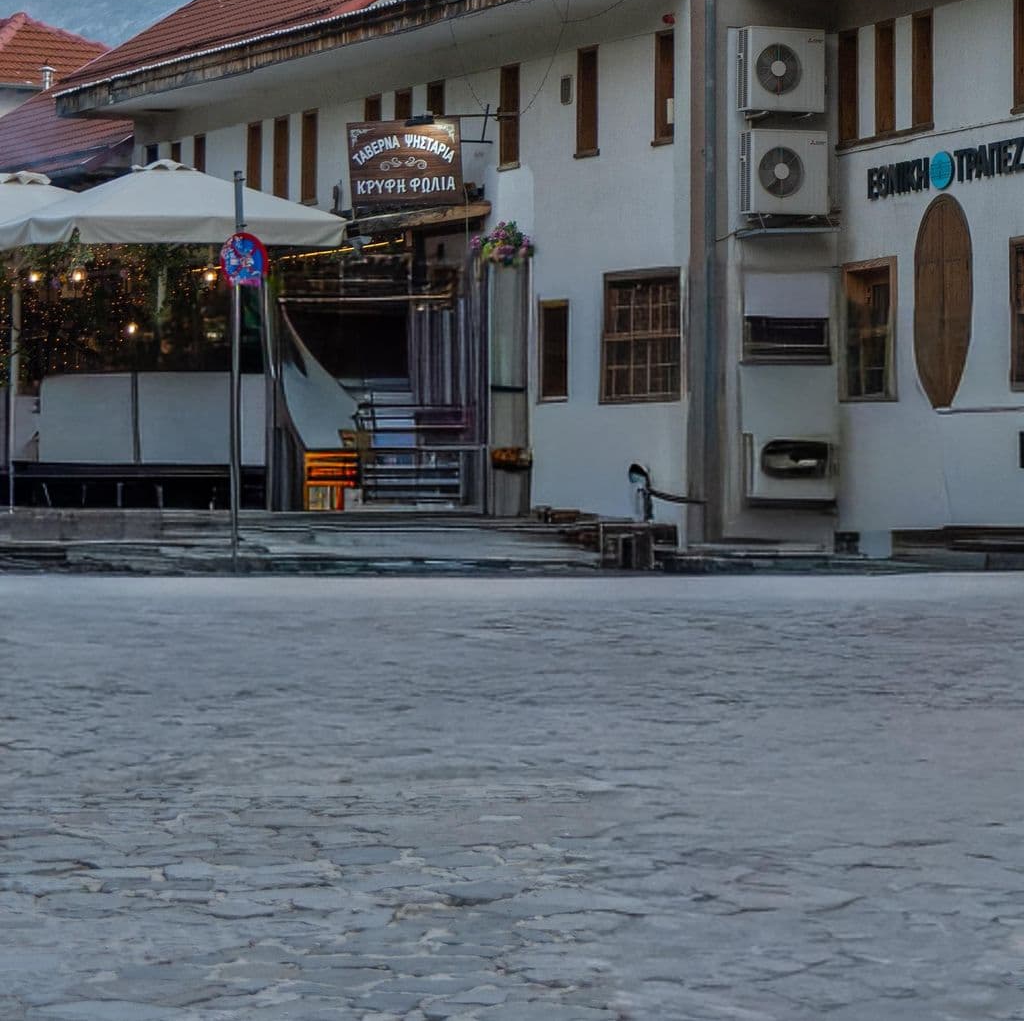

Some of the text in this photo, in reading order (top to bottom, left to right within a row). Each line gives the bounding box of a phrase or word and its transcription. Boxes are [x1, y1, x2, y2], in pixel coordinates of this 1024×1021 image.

[352, 134, 456, 166] ΤΑΒΕΡΝΑ ΨΗΣΤΑΡΙΑ
[356, 176, 456, 195] ΚΡΥΦΗ ΦΩΛΙΑ
[867, 156, 930, 200] ΕΘΝΙΚΗ
